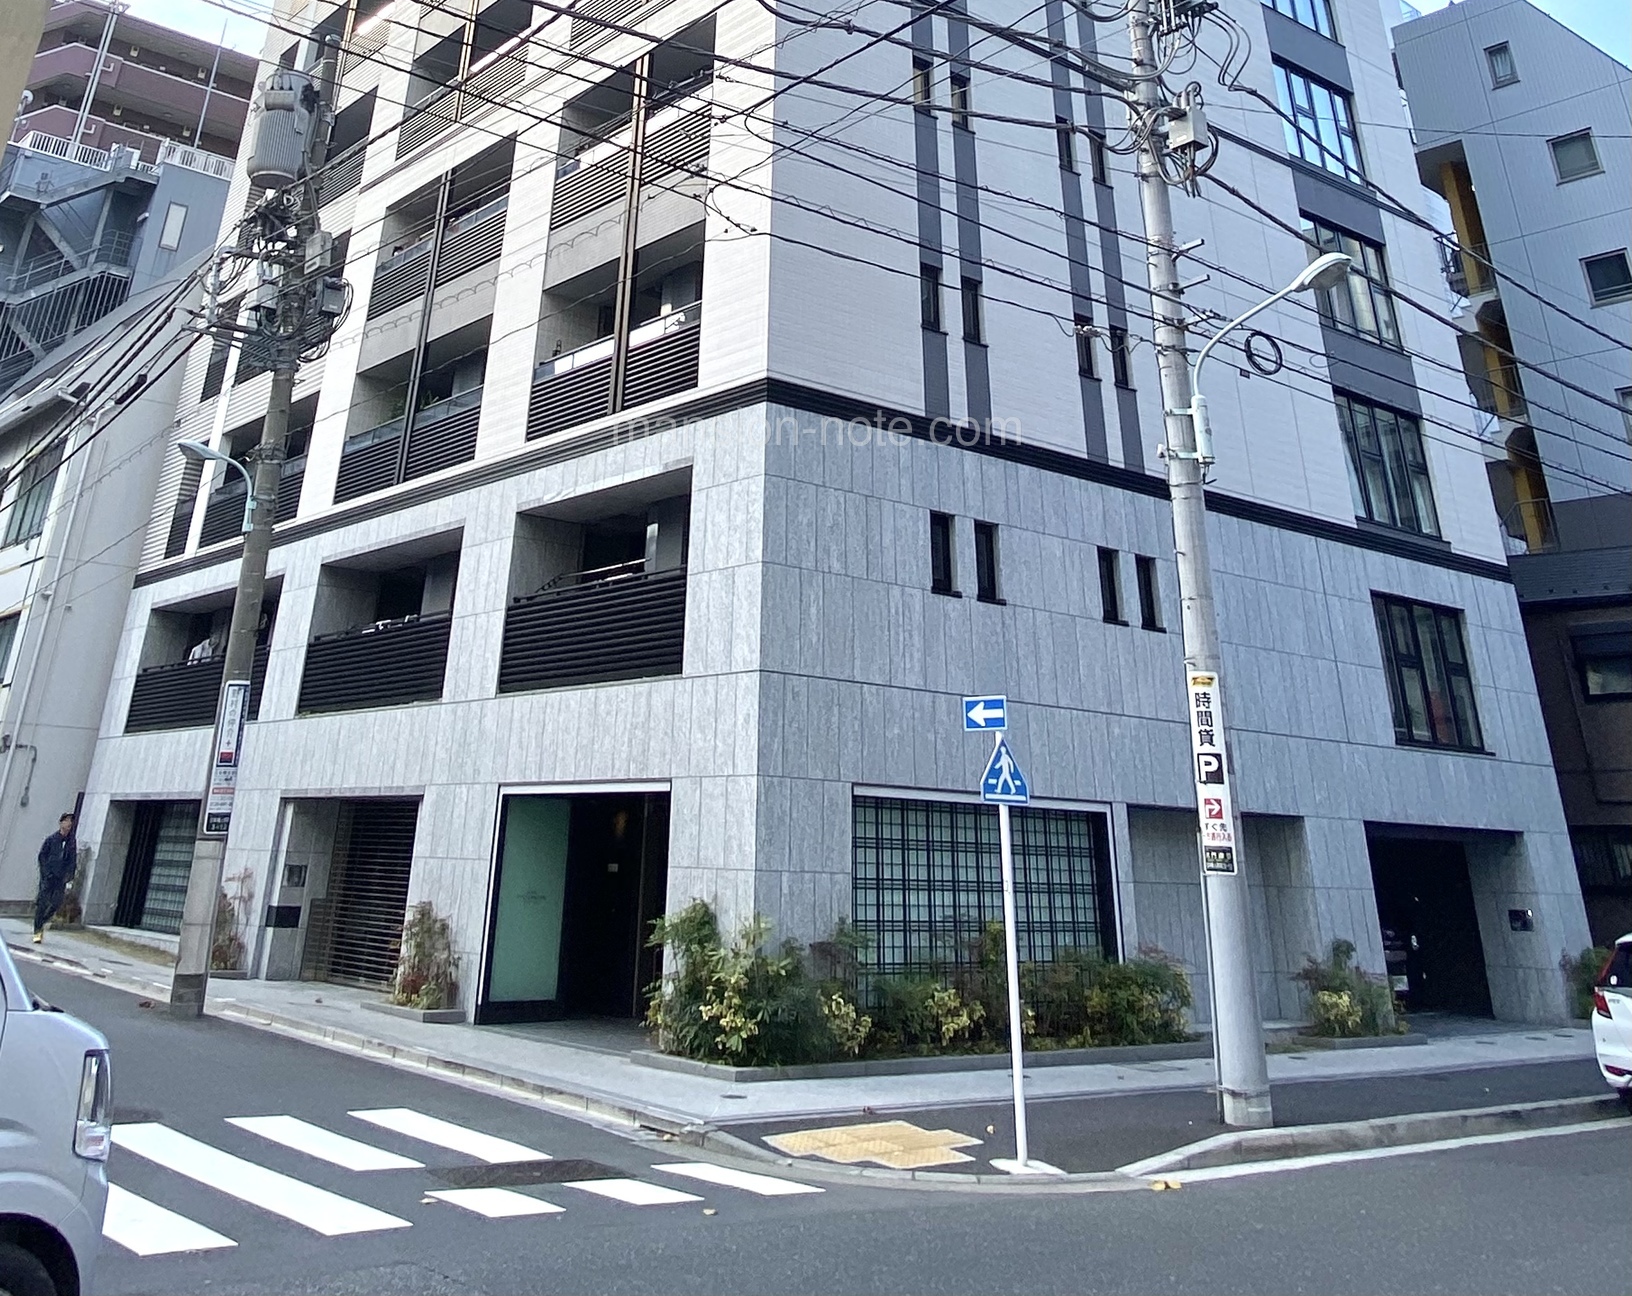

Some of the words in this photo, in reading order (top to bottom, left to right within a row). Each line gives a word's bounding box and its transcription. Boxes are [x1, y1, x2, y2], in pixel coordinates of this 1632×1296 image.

[1195, 692, 1215, 747] 時間貸
[1199, 754, 1220, 783] P
